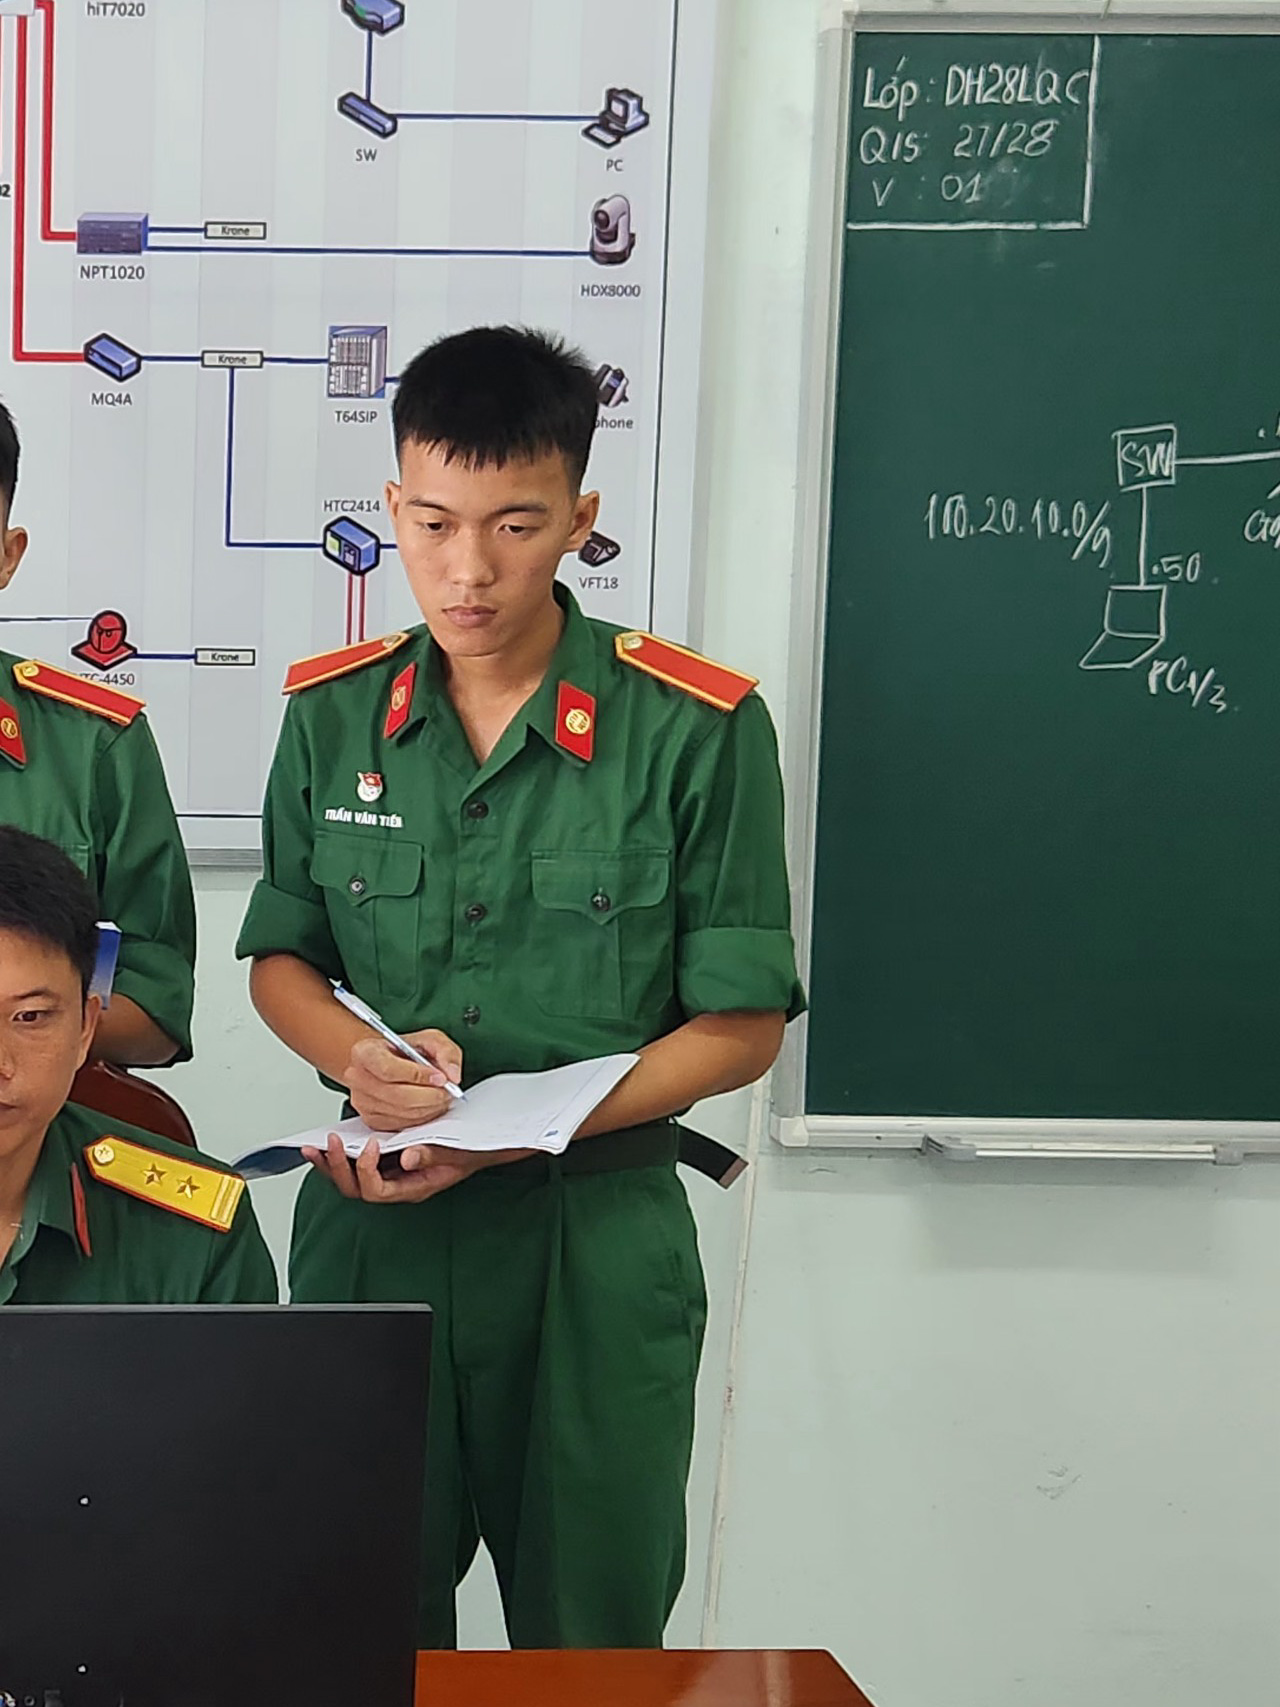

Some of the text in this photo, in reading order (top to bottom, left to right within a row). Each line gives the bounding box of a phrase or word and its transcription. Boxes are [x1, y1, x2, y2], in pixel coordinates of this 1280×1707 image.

[87, 0, 146, 17] hiT7020
[356, 149, 377, 162] SW
[606, 159, 623, 172] PC
[221, 226, 250, 236] Krone
[80, 265, 145, 280] NPT1020
[580, 284, 641, 298] HDX8000
[218, 355, 247, 365] Krone
[91, 392, 133, 407] MQ4A
[335, 410, 378, 423] T64SIP
[596, 416, 634, 429] hone
[1120, 441, 1173, 478] SW
[324, 499, 380, 513] HTC2414
[578, 576, 619, 590] VFT18
[211, 652, 240, 662] Krone
[80, 672, 136, 686] TC-4450
